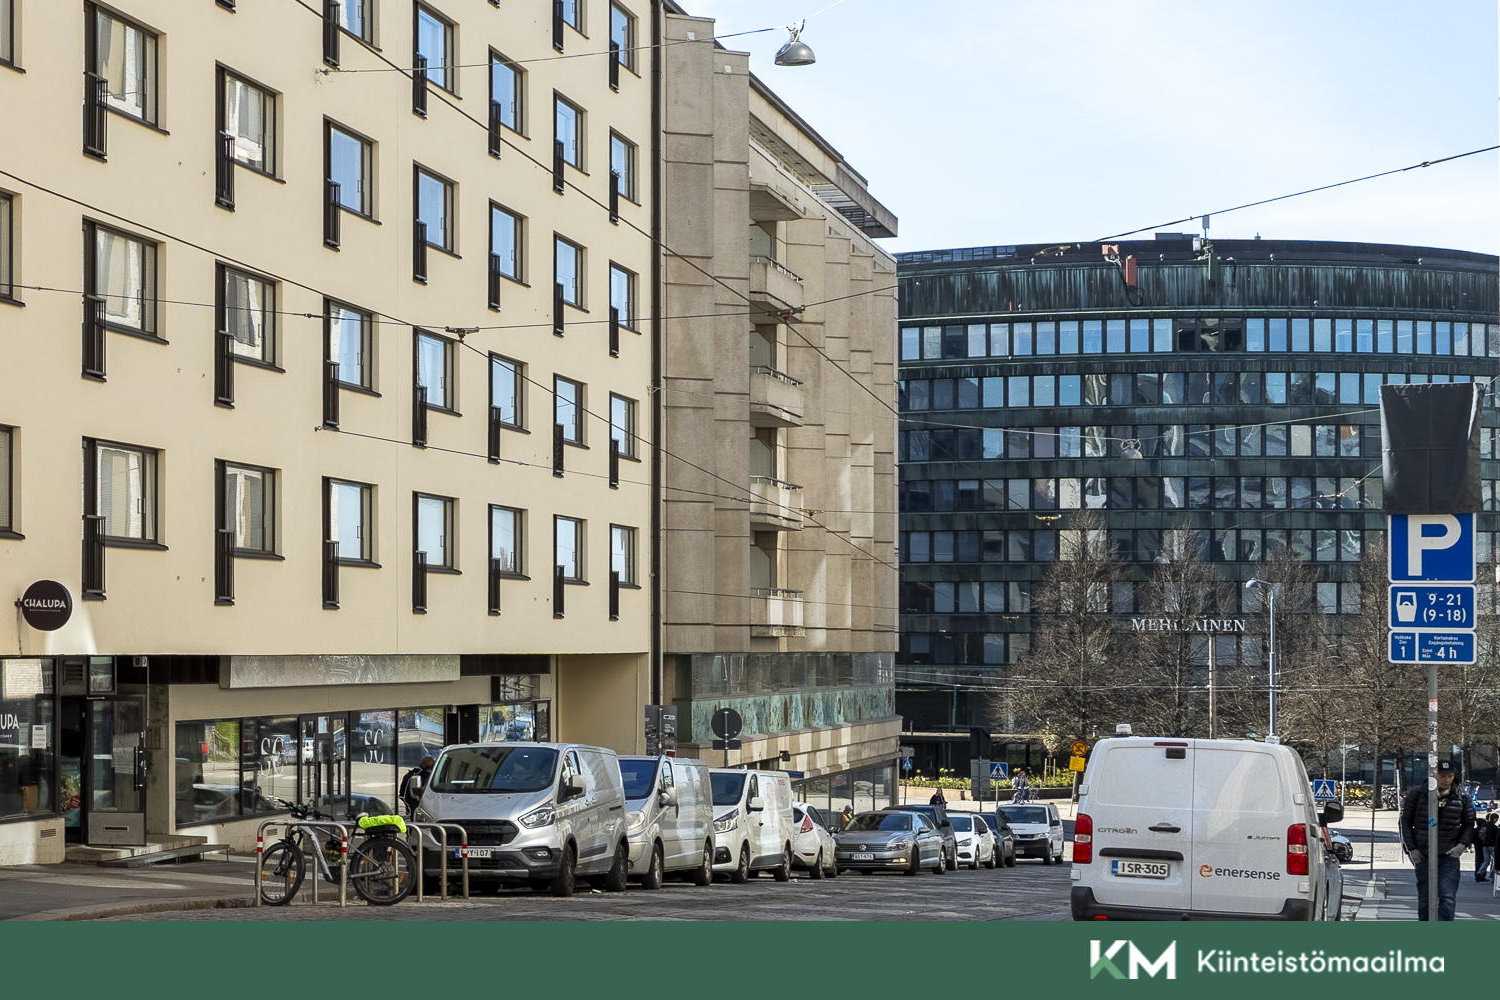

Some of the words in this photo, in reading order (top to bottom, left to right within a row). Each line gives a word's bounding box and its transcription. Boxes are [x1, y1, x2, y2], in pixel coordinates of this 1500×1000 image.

[1408, 514, 1462, 576] P
[24, 599, 66, 608] CHALUPA
[1400, 646, 1406, 658] 1
[1449, 647, 1457, 659] h
[1121, 862, 1167, 875] ISR-305
[1214, 867, 1281, 881] enersense
